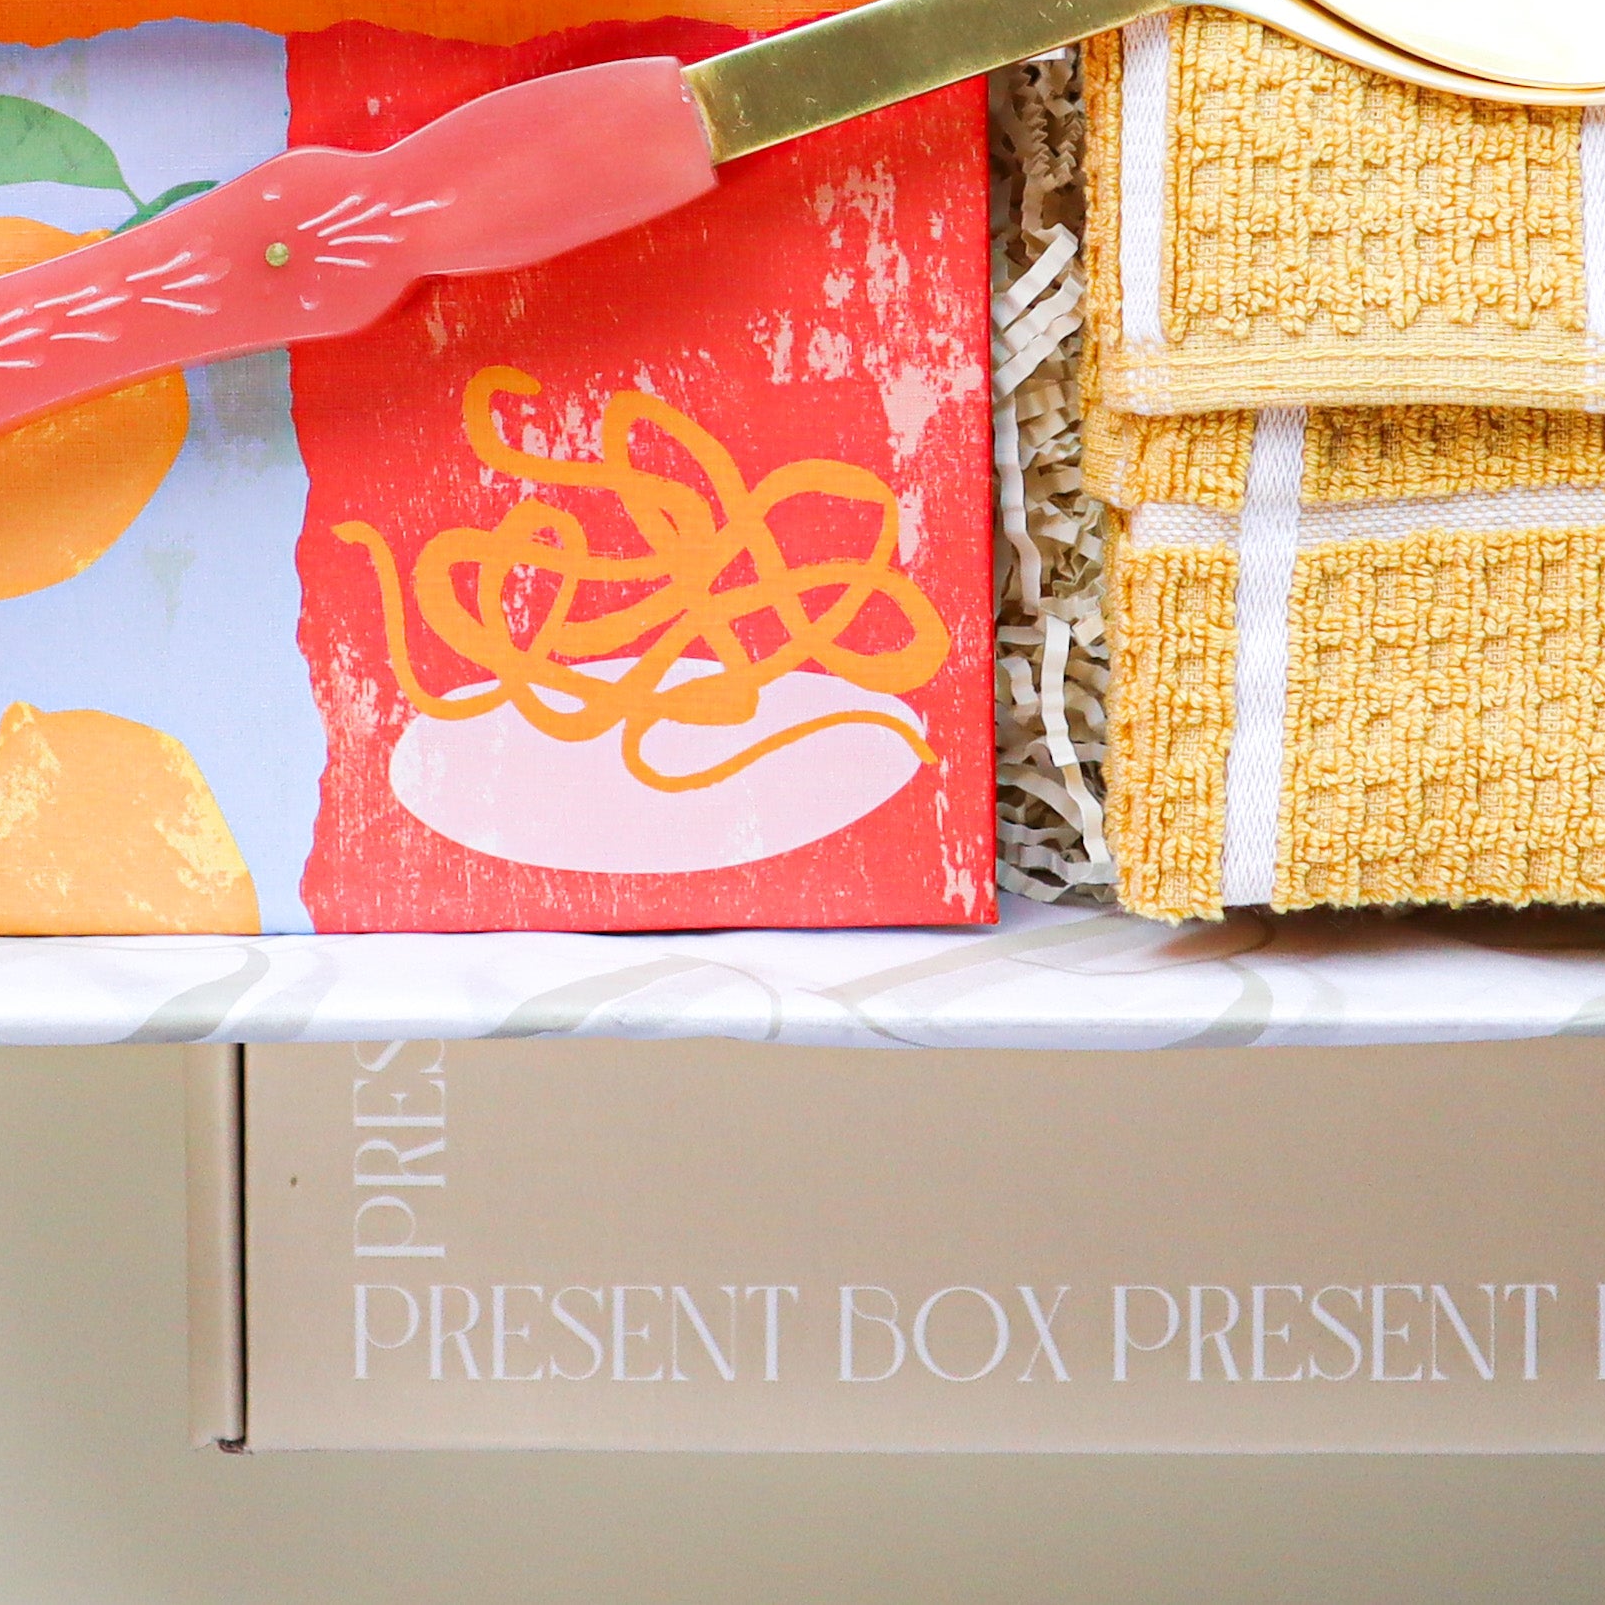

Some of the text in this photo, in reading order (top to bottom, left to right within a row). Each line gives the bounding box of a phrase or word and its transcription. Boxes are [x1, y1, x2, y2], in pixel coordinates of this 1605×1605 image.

[351, 1284, 799, 1383] PRESENT
[838, 1284, 1073, 1383] BOX
[1111, 1283, 1558, 1383] PRESENT
